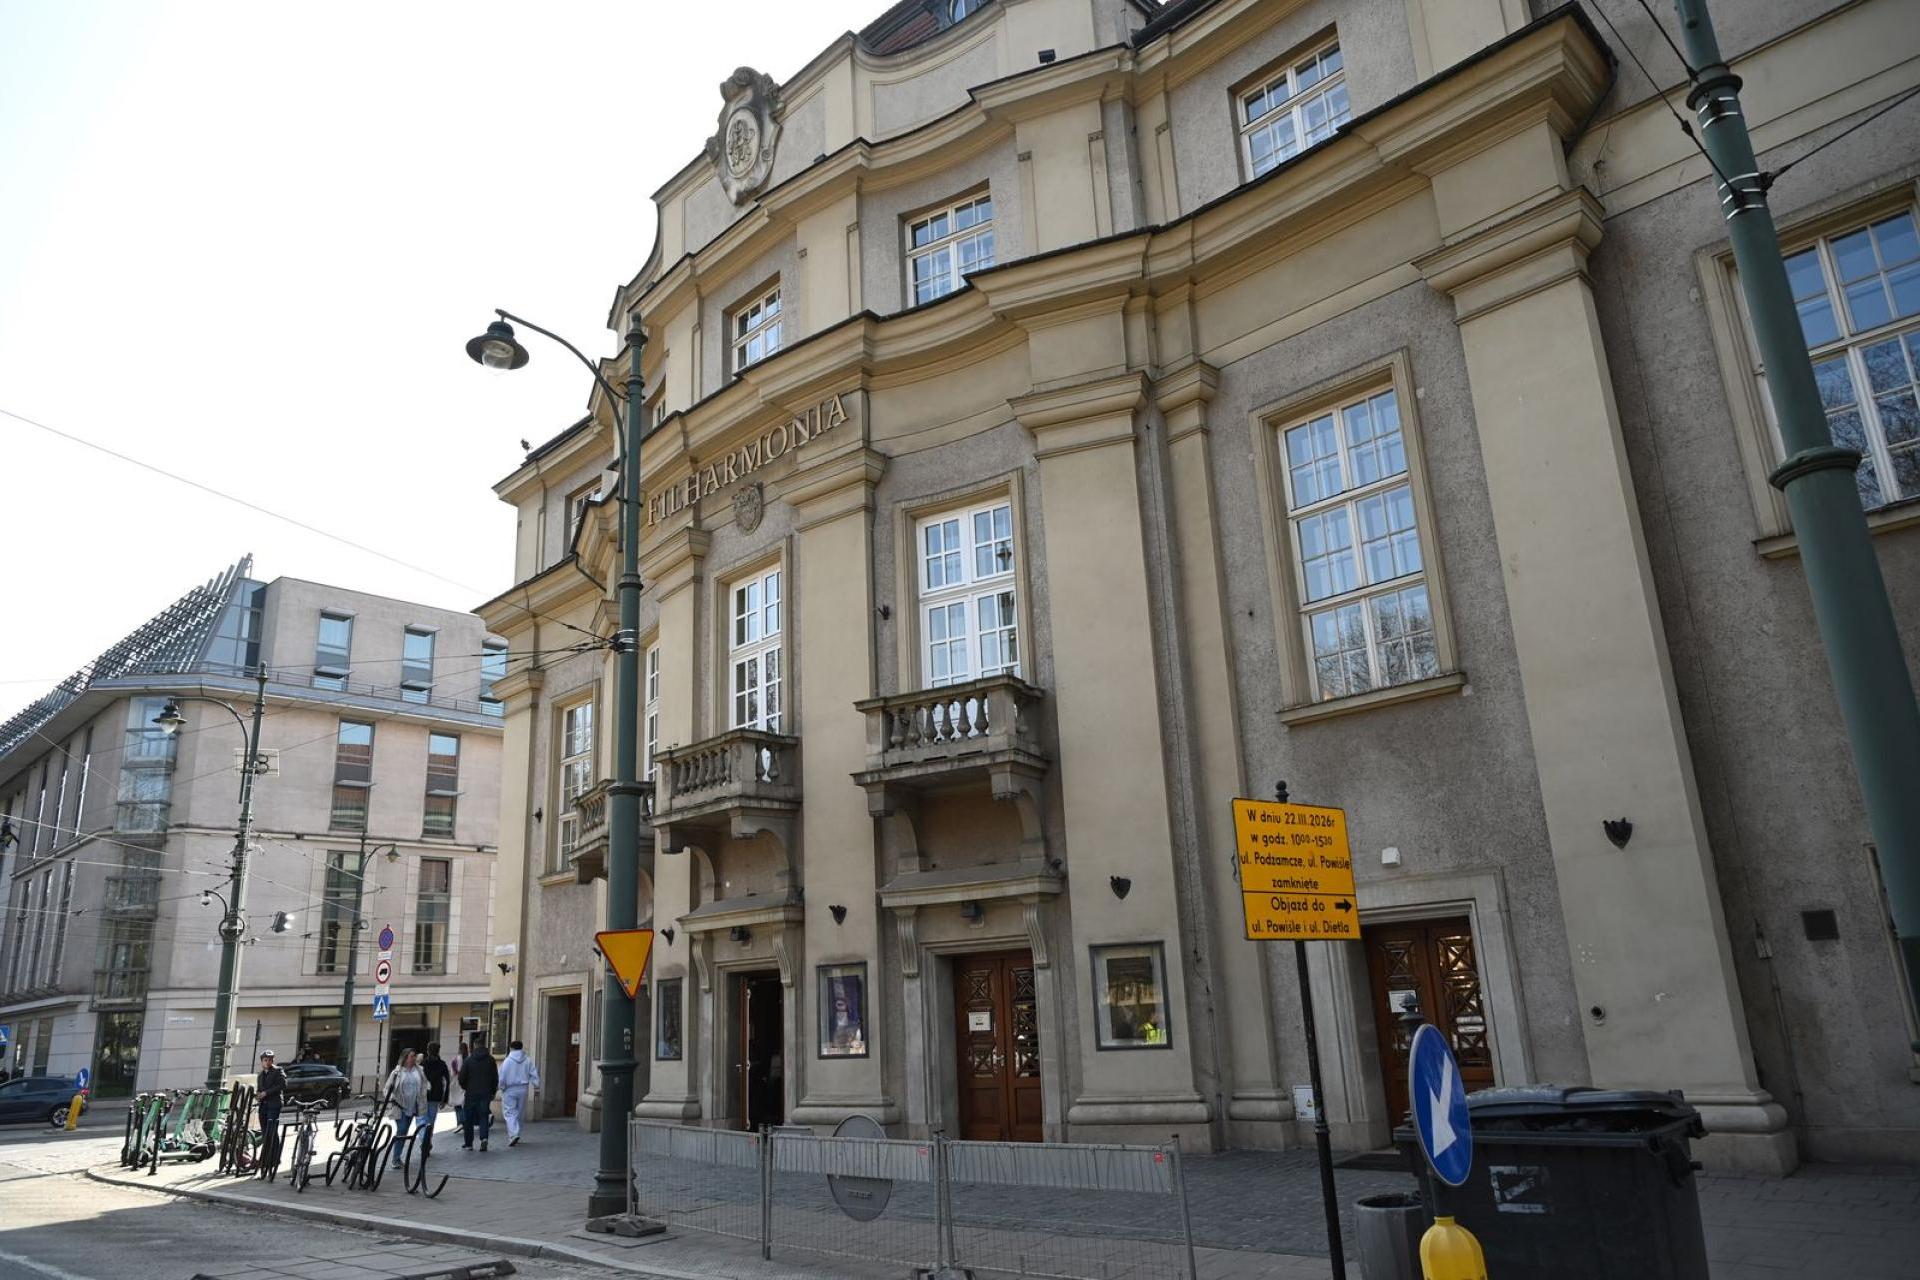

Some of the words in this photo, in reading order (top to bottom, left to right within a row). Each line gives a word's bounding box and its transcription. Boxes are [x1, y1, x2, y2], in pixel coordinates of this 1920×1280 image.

[647, 394, 849, 526] FILHARMONIA
[1247, 809, 1256, 822] W
[1260, 810, 1281, 824] dniu
[1251, 834, 1259, 843] w
[1262, 832, 1288, 847] godz.
[1240, 851, 1252, 865] ul.
[1270, 896, 1309, 914] Objazd
[1312, 897, 1326, 912] do
[1251, 919, 1264, 933] ul.
[1322, 919, 1350, 934] Dietla
